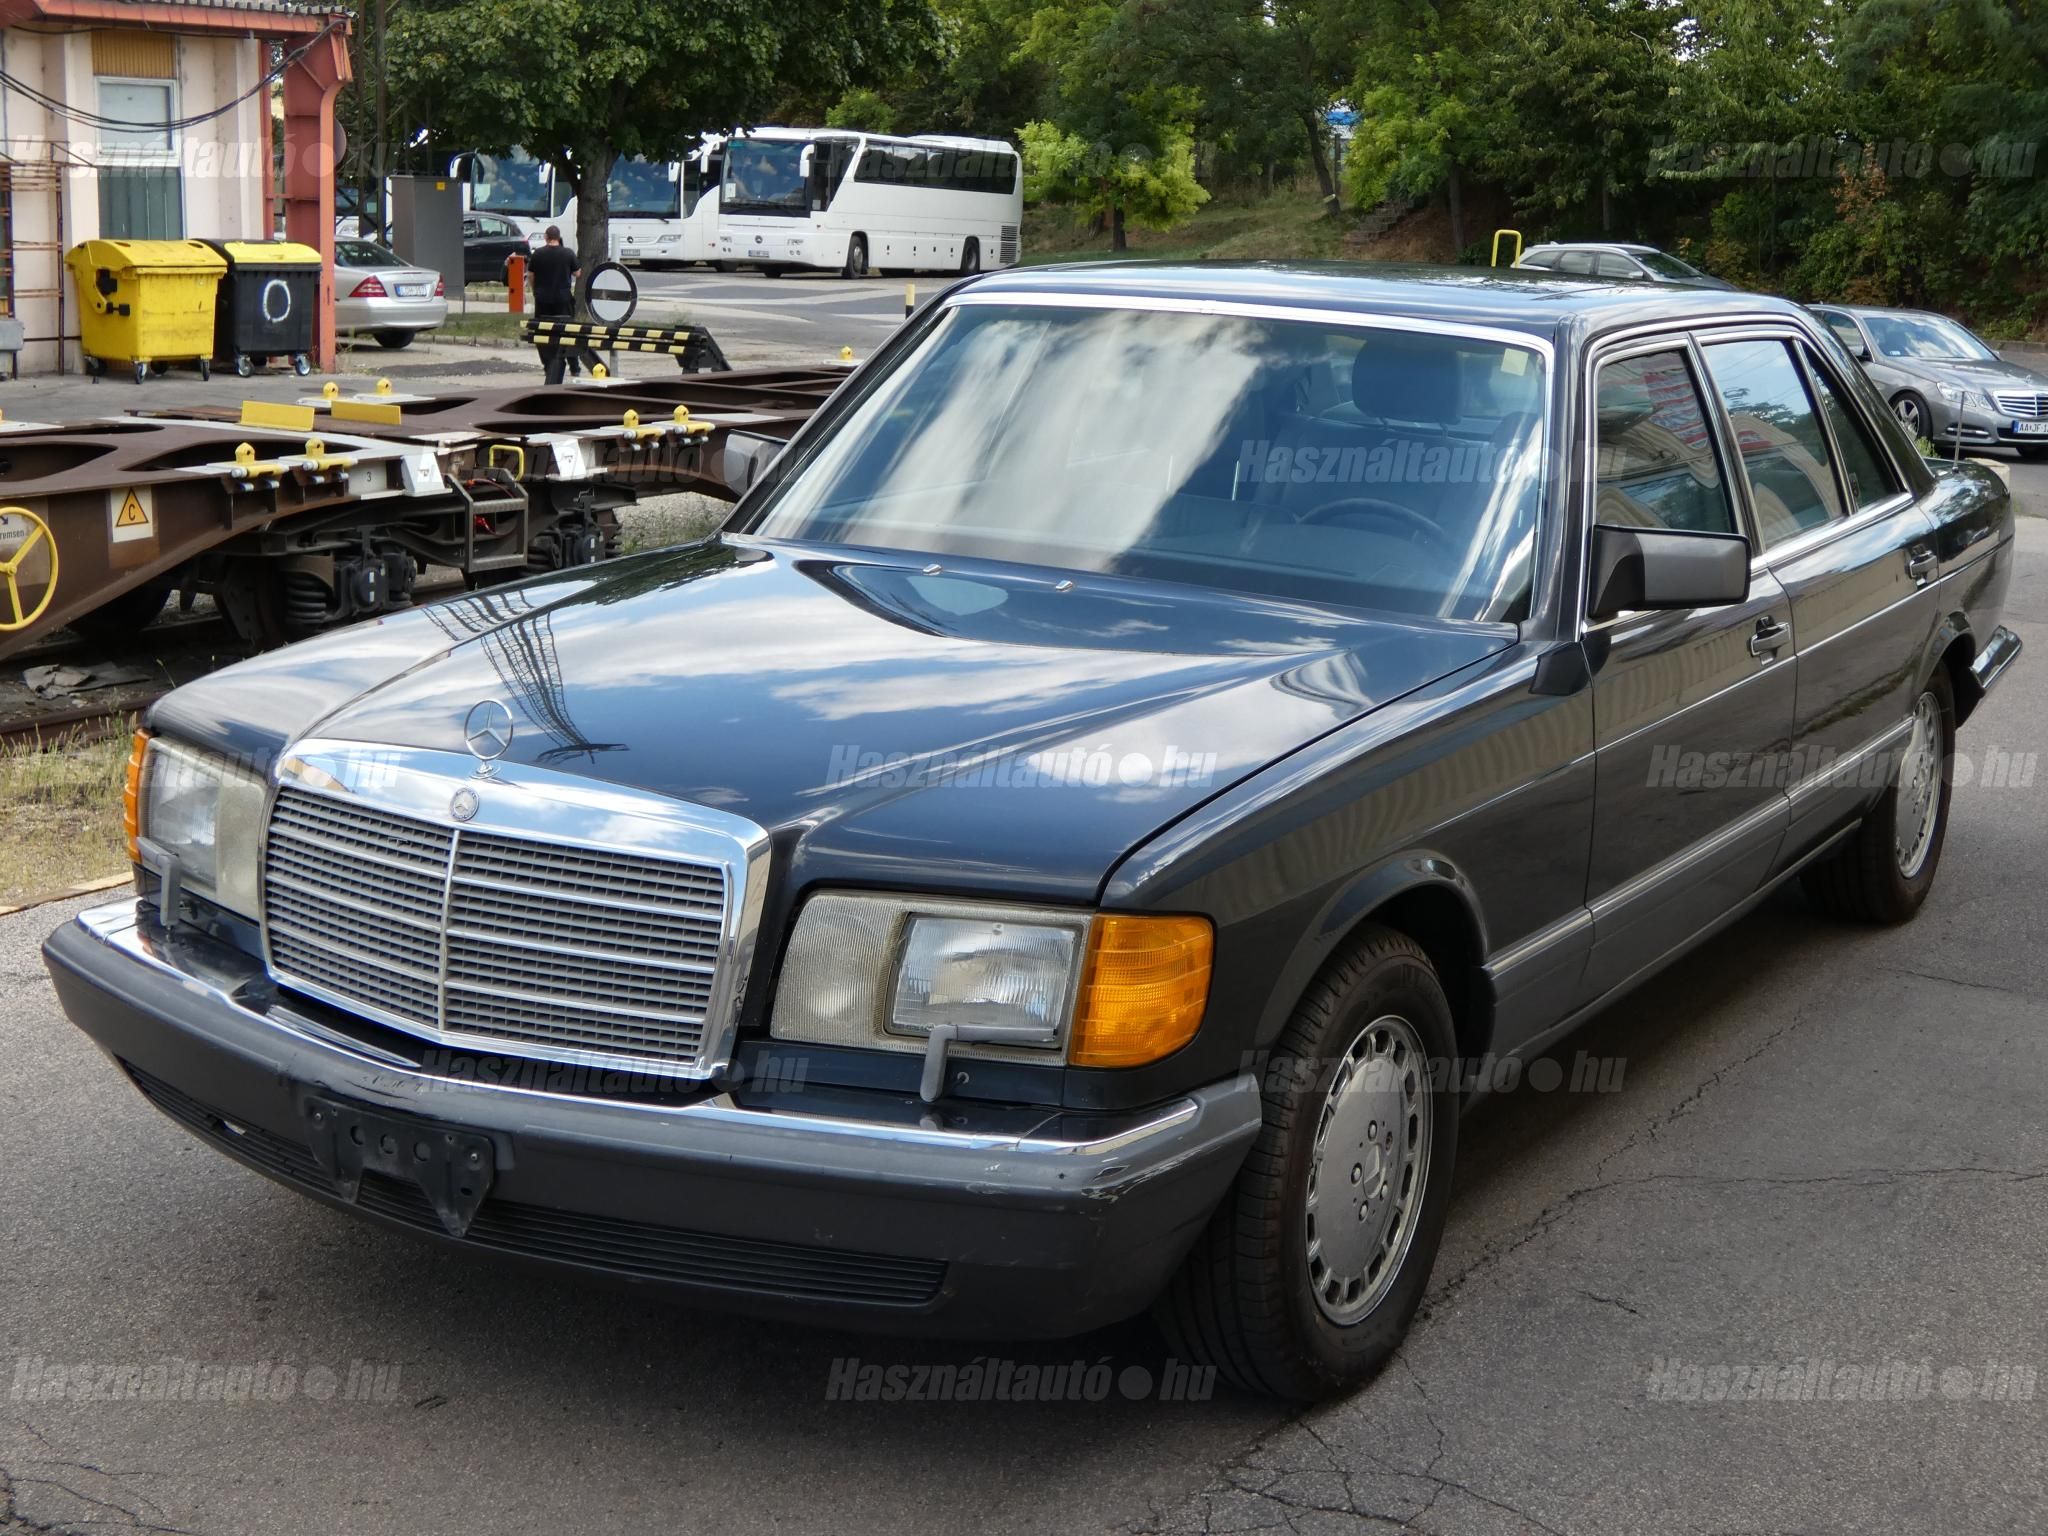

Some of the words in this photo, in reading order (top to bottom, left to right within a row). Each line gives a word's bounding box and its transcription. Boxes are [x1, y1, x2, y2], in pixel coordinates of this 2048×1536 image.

[366, 471, 372, 481] 3
[128, 503, 136, 521] C
[0, 529, 25, 540] remsen
